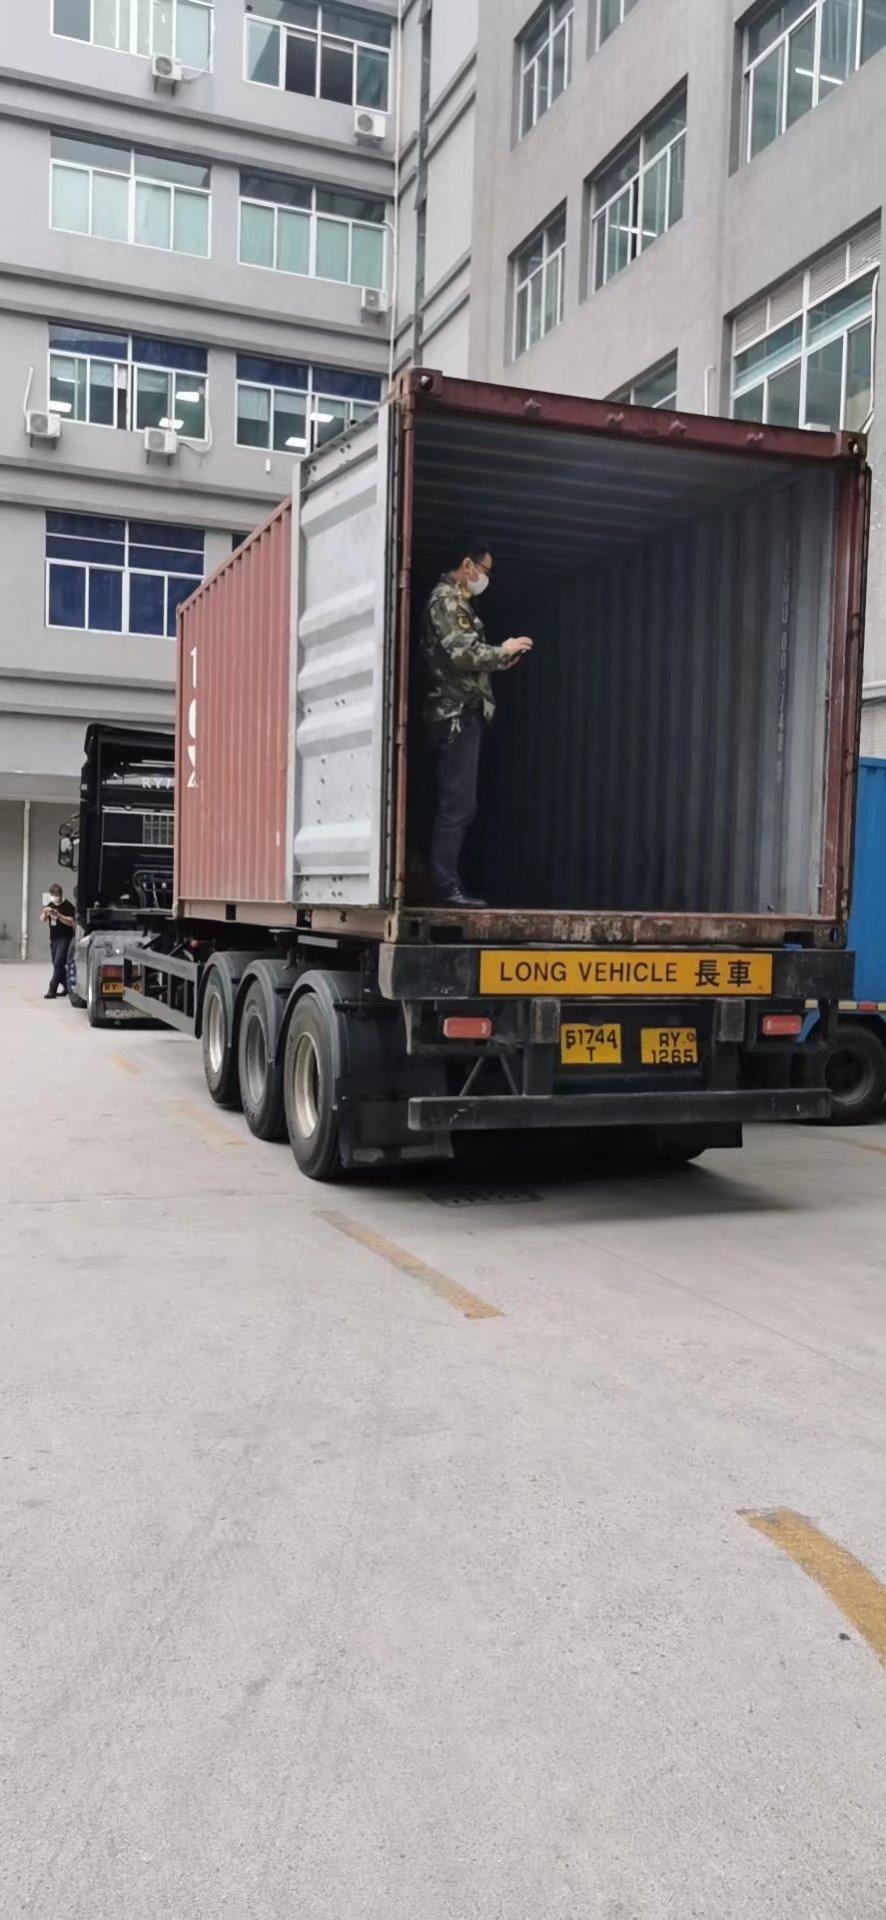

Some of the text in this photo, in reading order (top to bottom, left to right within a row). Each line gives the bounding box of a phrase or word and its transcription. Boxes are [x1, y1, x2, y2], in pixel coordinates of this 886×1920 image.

[500, 961, 678, 983] LONG VEHICLE
[695, 959, 752, 988] 長車
[565, 1029, 617, 1049] 51744
[659, 1032, 680, 1048] RY
[586, 1046, 596, 1062] T
[650, 1049, 694, 1065] 1265
